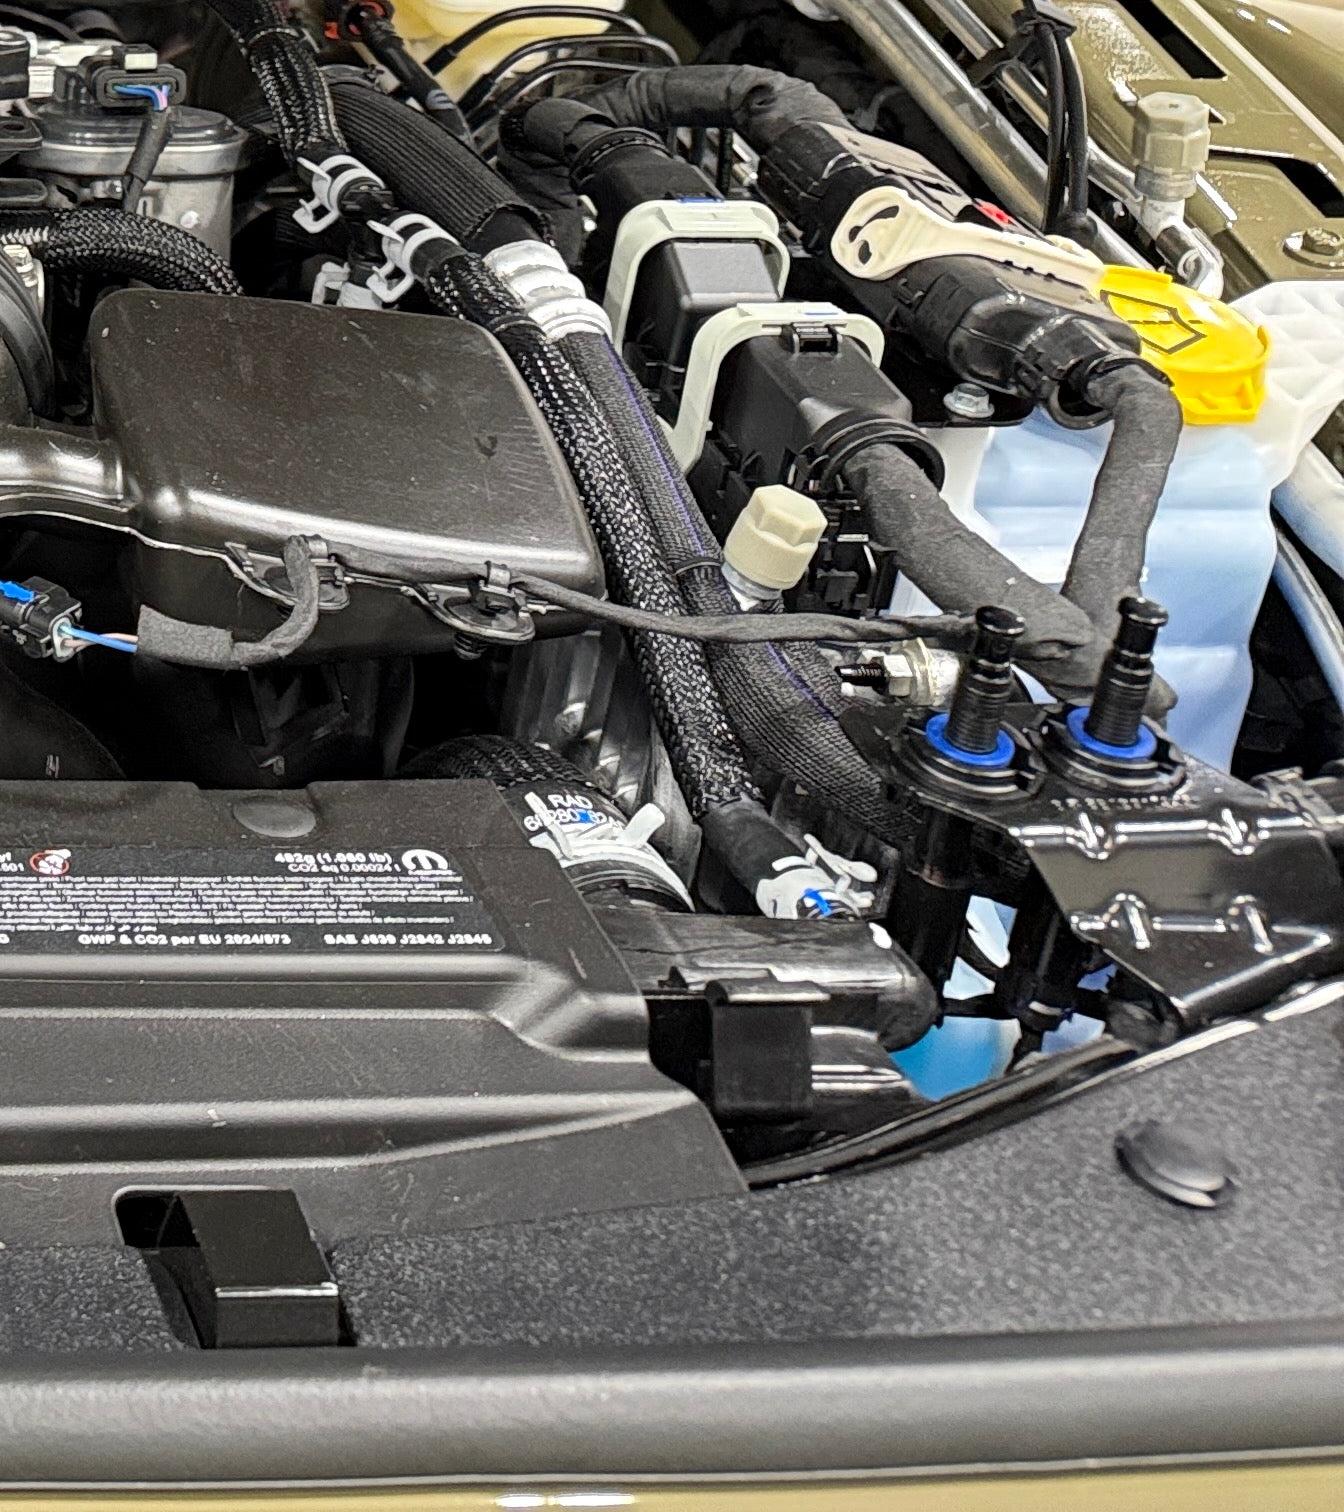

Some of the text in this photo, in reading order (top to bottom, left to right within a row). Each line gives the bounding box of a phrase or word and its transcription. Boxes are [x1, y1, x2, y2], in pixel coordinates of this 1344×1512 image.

[547, 794, 593, 809] RAD
[288, 863, 319, 872] CO2
[78, 934, 116, 945] GWP
[134, 934, 168, 945] CO2
[171, 935, 196, 946] per
[198, 934, 222, 945] EU
[323, 933, 358, 945] SAE
